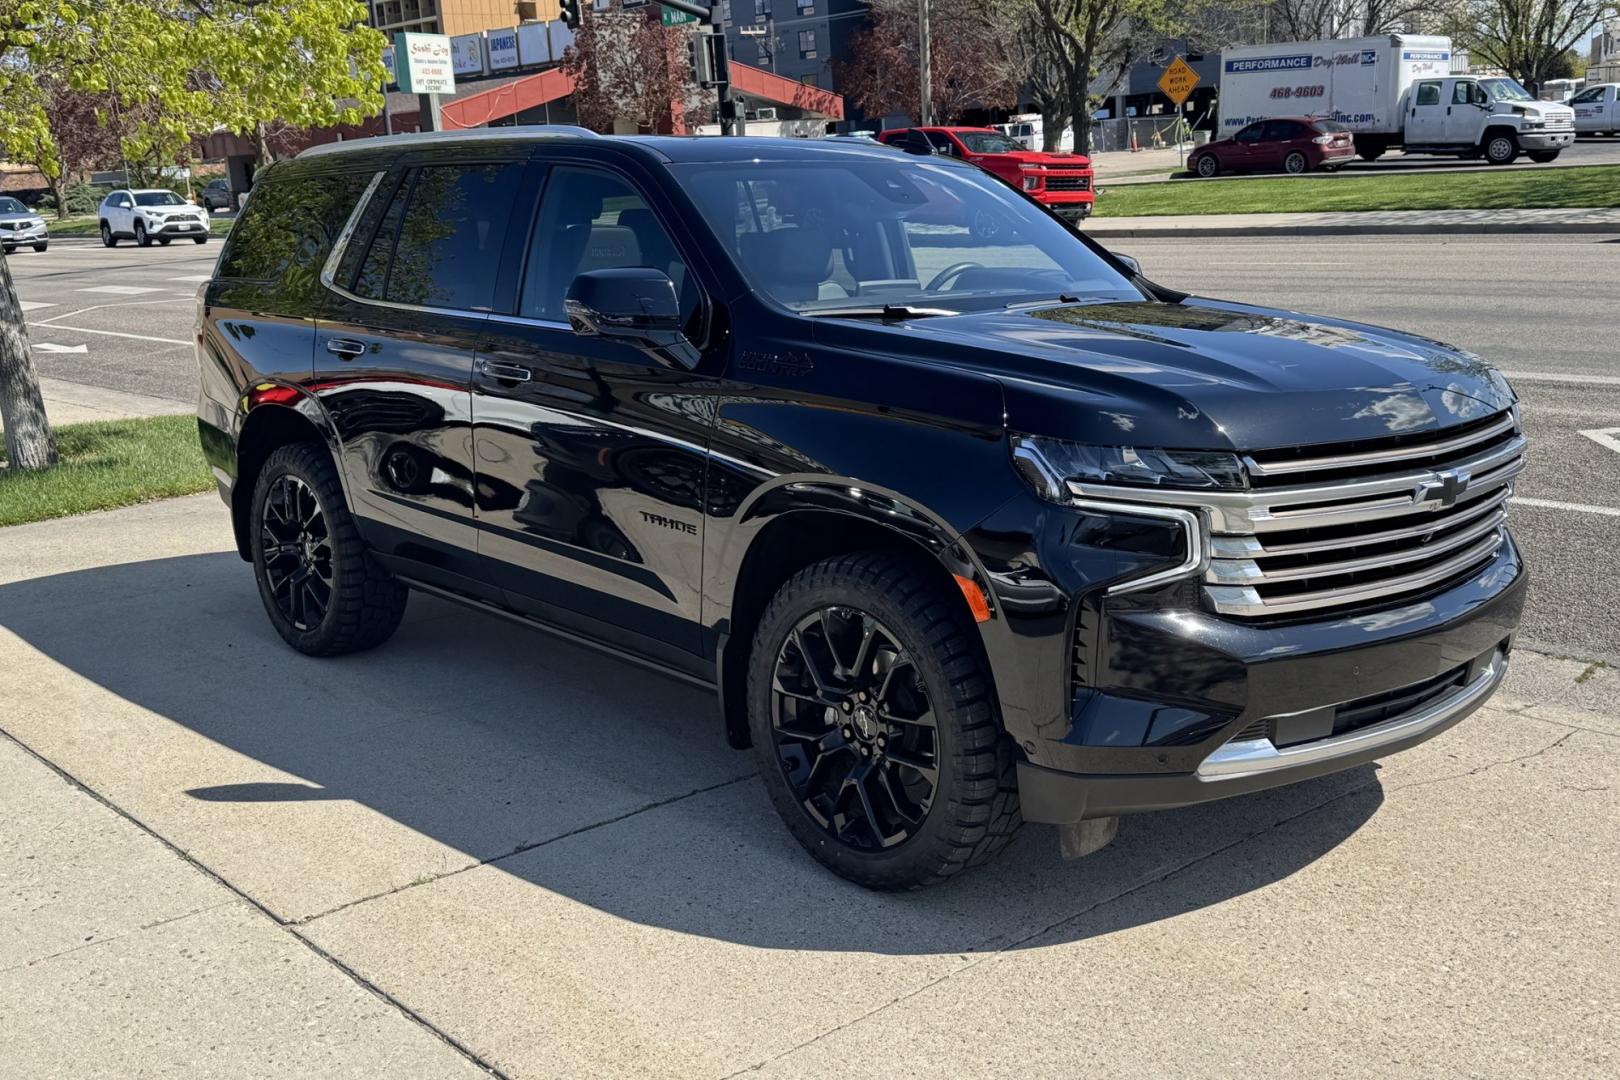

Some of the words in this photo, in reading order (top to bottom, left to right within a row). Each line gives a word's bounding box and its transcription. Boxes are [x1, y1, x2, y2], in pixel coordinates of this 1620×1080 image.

[671, 10, 687, 23] MAIN
[491, 35, 515, 52] JAPANESE
[1233, 57, 1308, 71] PERFORMANCE
[1168, 85, 1190, 93] AHEAD
[1270, 85, 1325, 99] 468-9603
[639, 511, 697, 535] TAHOE
